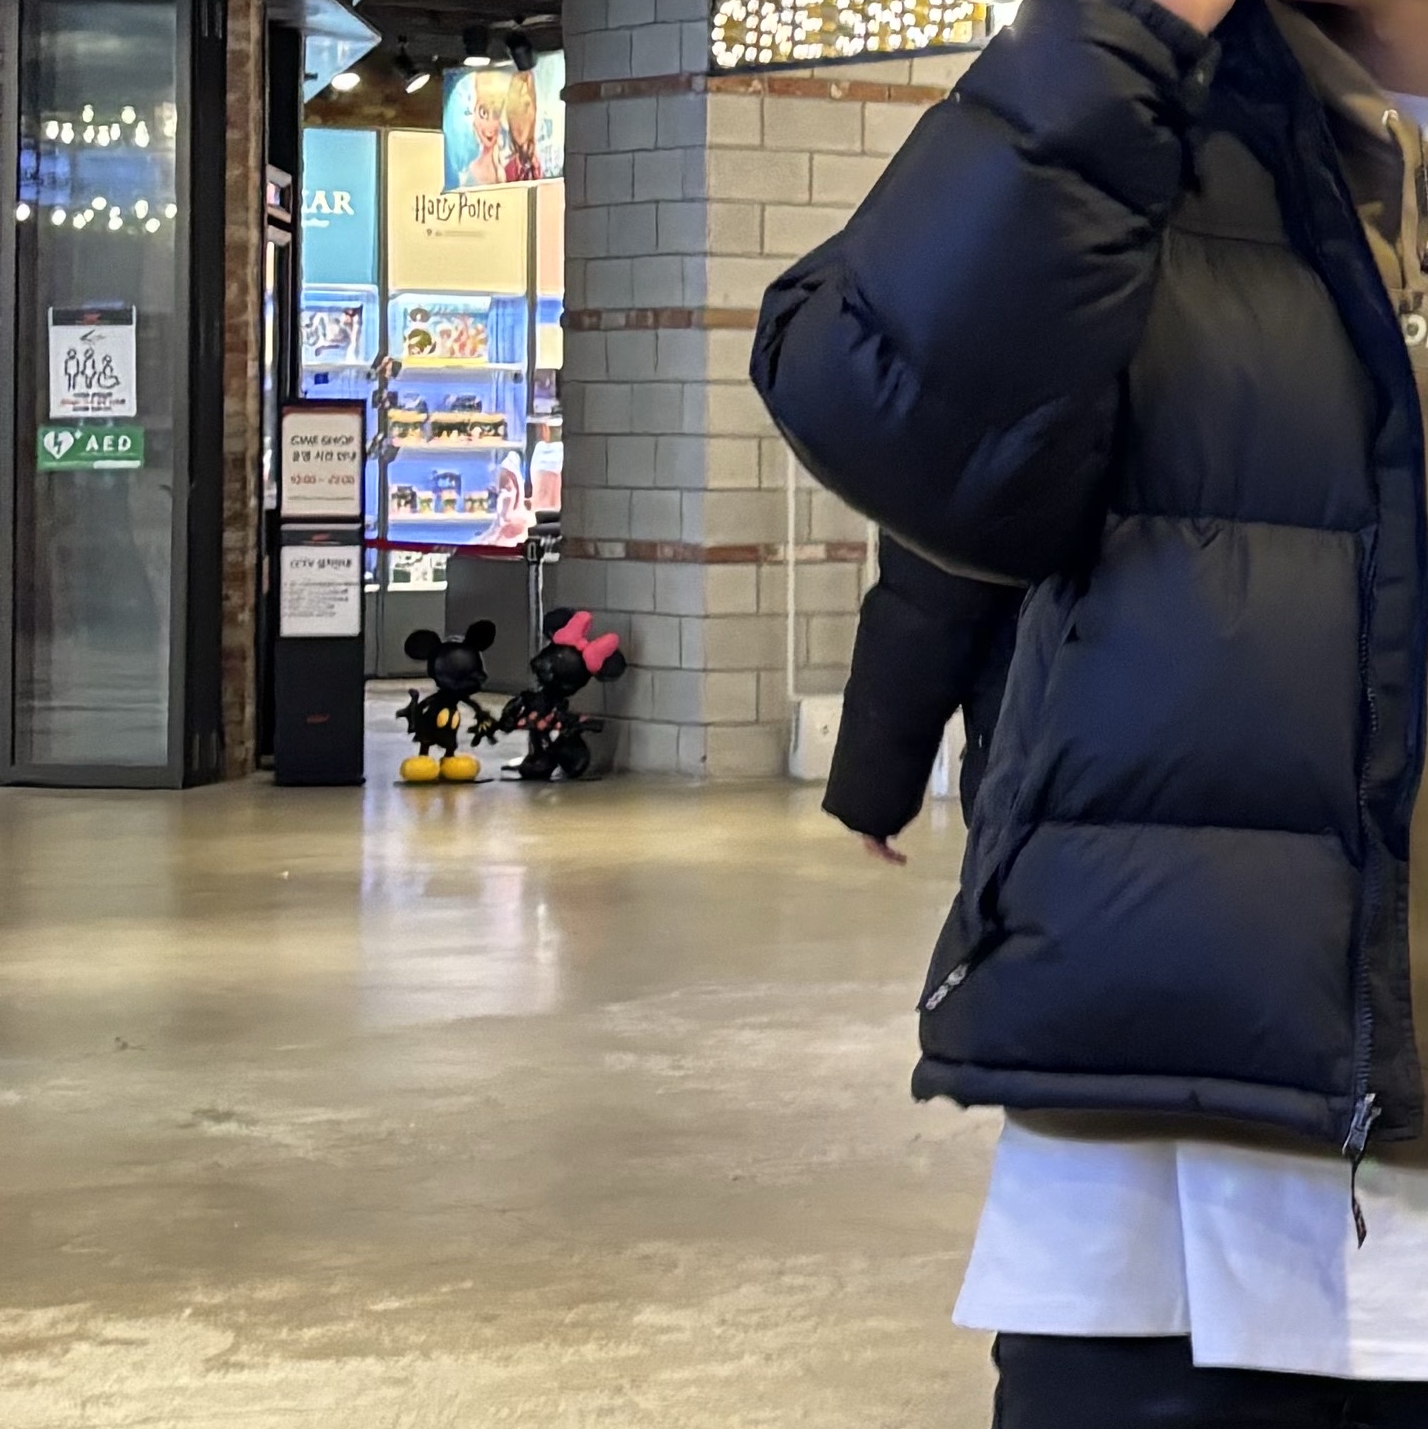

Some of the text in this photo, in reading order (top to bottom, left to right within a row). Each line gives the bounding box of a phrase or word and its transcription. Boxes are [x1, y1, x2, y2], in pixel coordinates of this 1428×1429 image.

[414, 191, 502, 224] Harry Potter
[85, 434, 132, 452] AED
